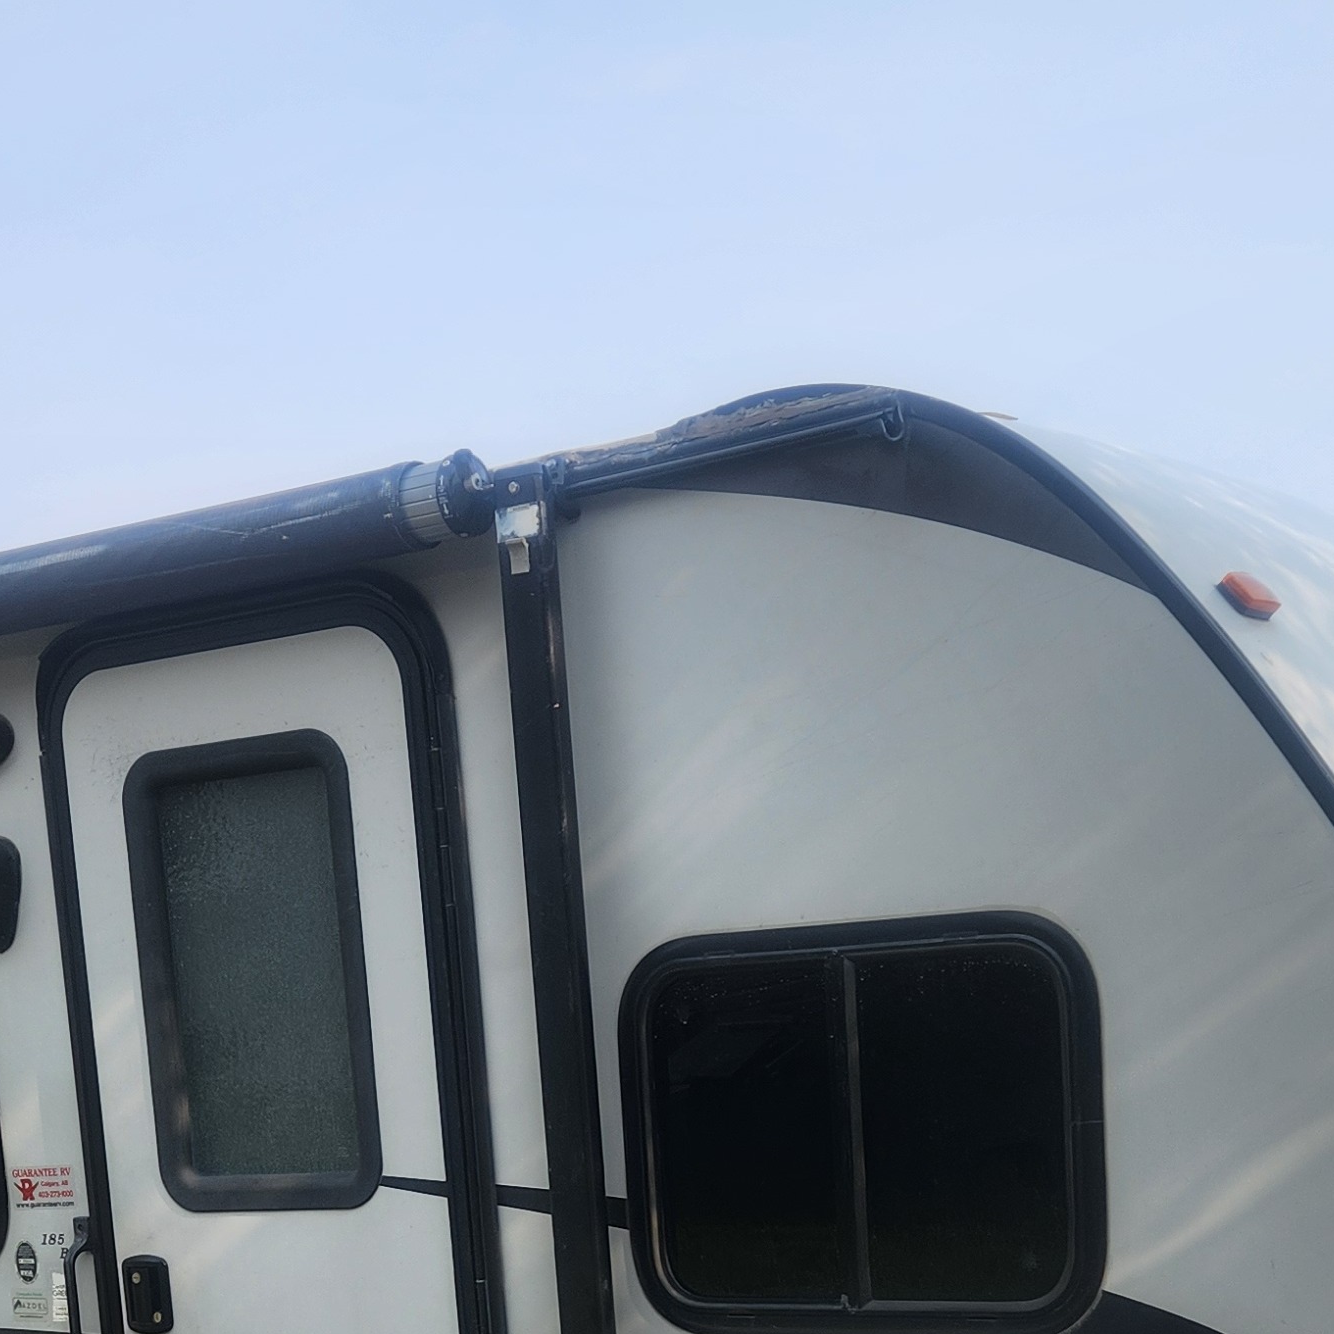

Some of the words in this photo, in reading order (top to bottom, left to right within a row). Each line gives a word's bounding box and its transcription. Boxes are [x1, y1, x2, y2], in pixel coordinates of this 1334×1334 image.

[12, 1168, 58, 1178] GUARANTEE
[60, 1167, 71, 1176] RV
[41, 1233, 65, 1245] 185
